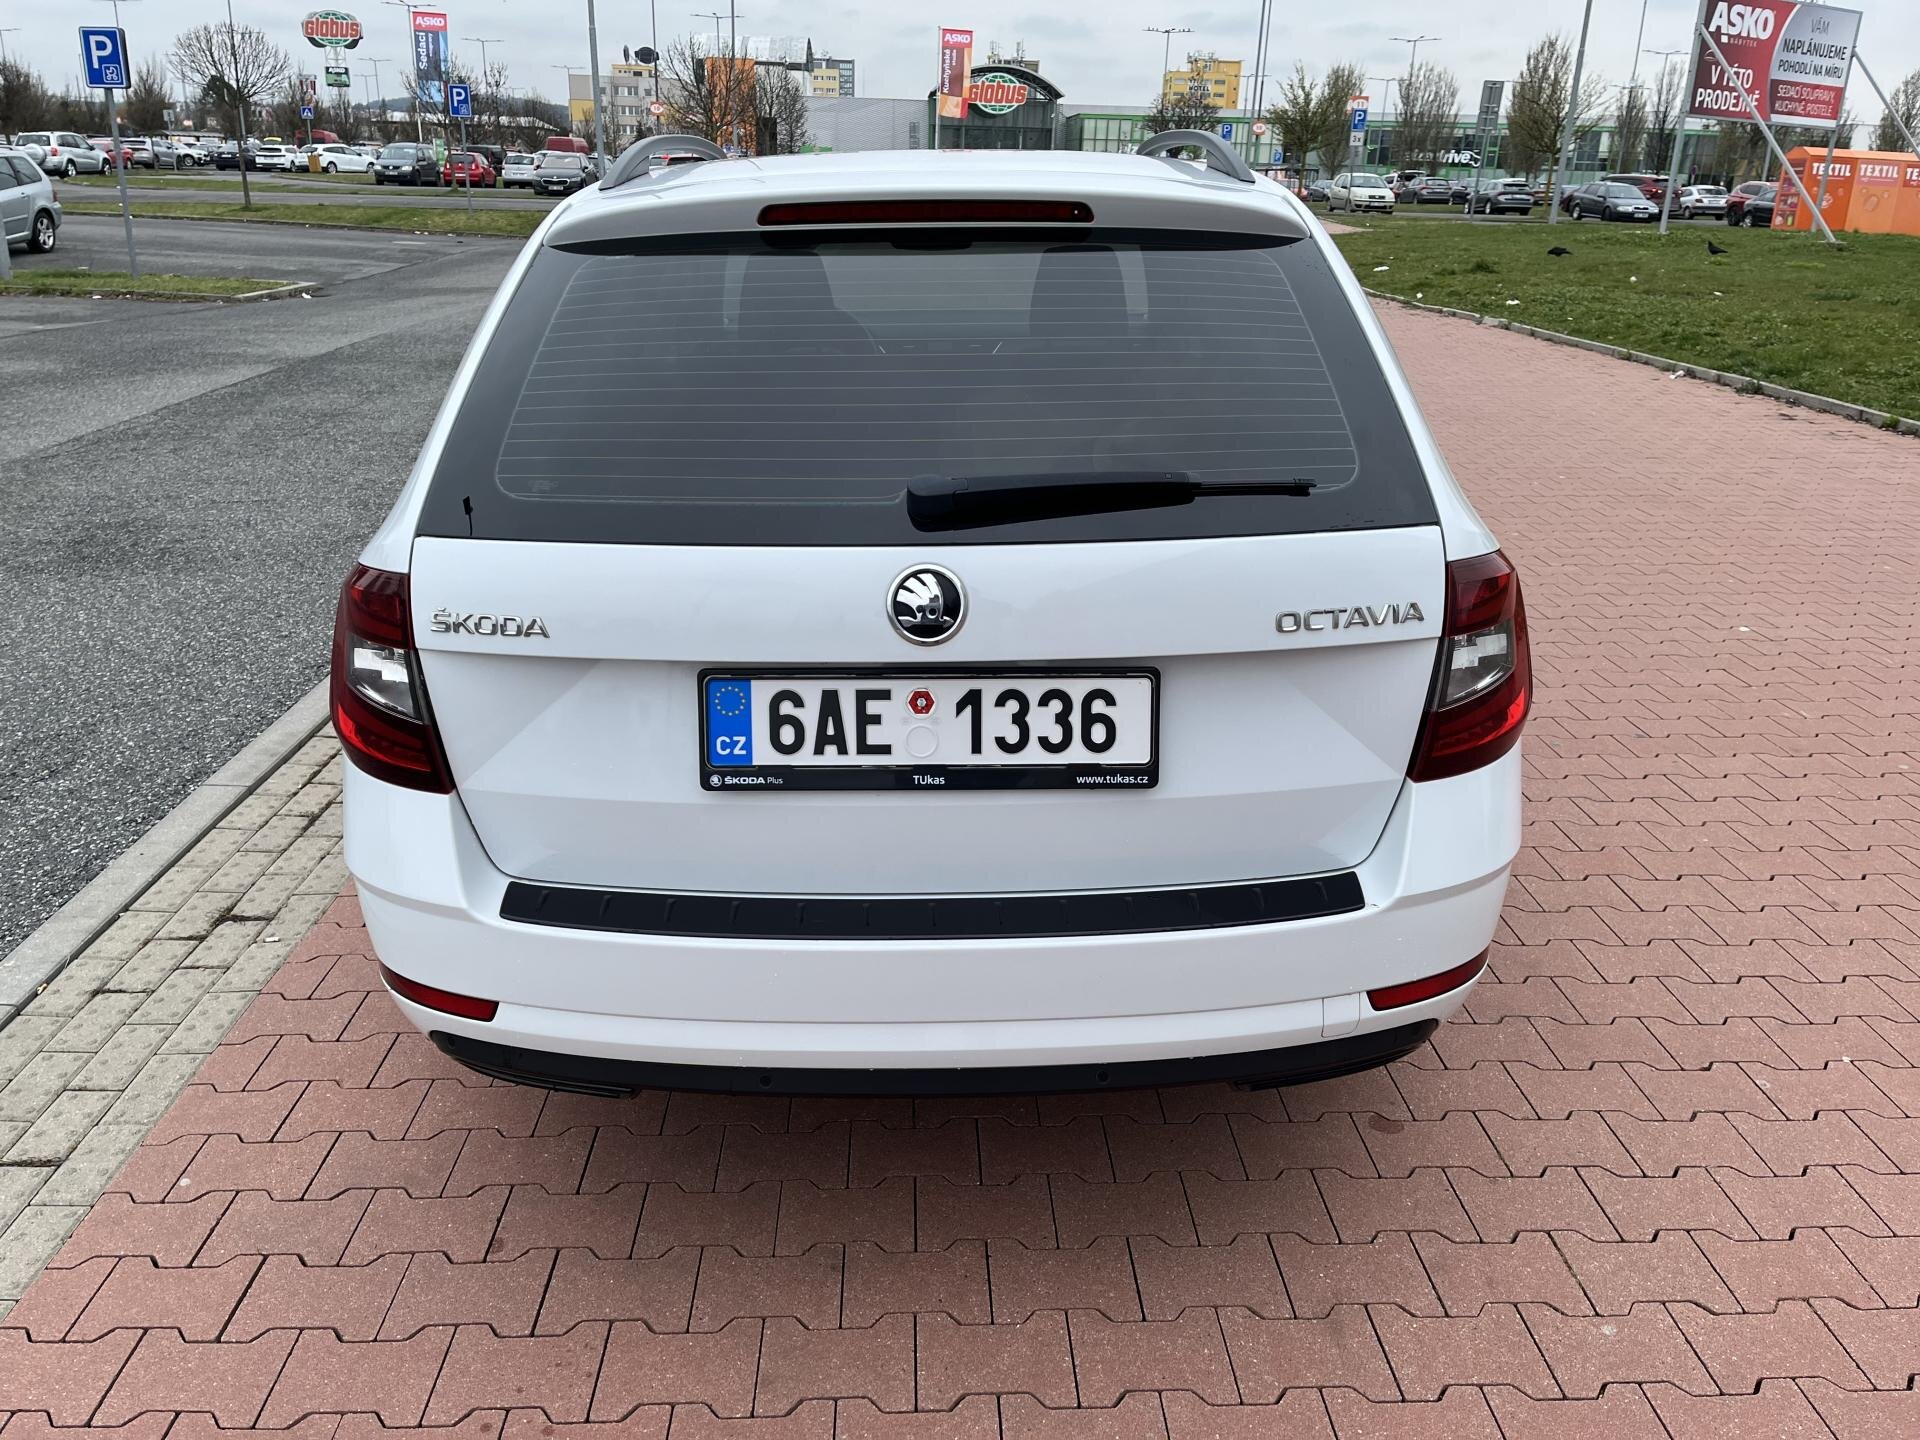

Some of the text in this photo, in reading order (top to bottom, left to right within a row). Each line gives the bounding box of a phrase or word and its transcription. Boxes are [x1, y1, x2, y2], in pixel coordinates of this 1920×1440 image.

[303, 16, 360, 38] Globus
[415, 16, 445, 26] ASKO
[1708, 1, 1775, 40] ASKO
[1811, 17, 1830, 35] VÁM
[944, 33, 971, 44] ASKO
[88, 34, 113, 69] P
[1782, 38, 1848, 61] NAPLÁNUJEME
[1711, 63, 1754, 89] V TÉTO
[1778, 59, 1844, 79] POHODLÍ NA MÍRU
[453, 88, 466, 107] P
[969, 79, 1028, 105] Globus
[1355, 111, 1365, 124] P
[1224, 125, 1231, 135] P
[1860, 164, 1899, 178] TEXTIL
[1905, 167, 1920, 180] TE
[430, 607, 550, 639] ŠKODA
[1275, 601, 1425, 633] OCTAVIA
[769, 688, 1117, 756] 6AE 1336
[716, 735, 747, 756] CZ
[724, 773, 784, 785] ŠKODA Plus
[912, 774, 946, 786] TUkas
[1076, 774, 1149, 785] www.tukas.cz
